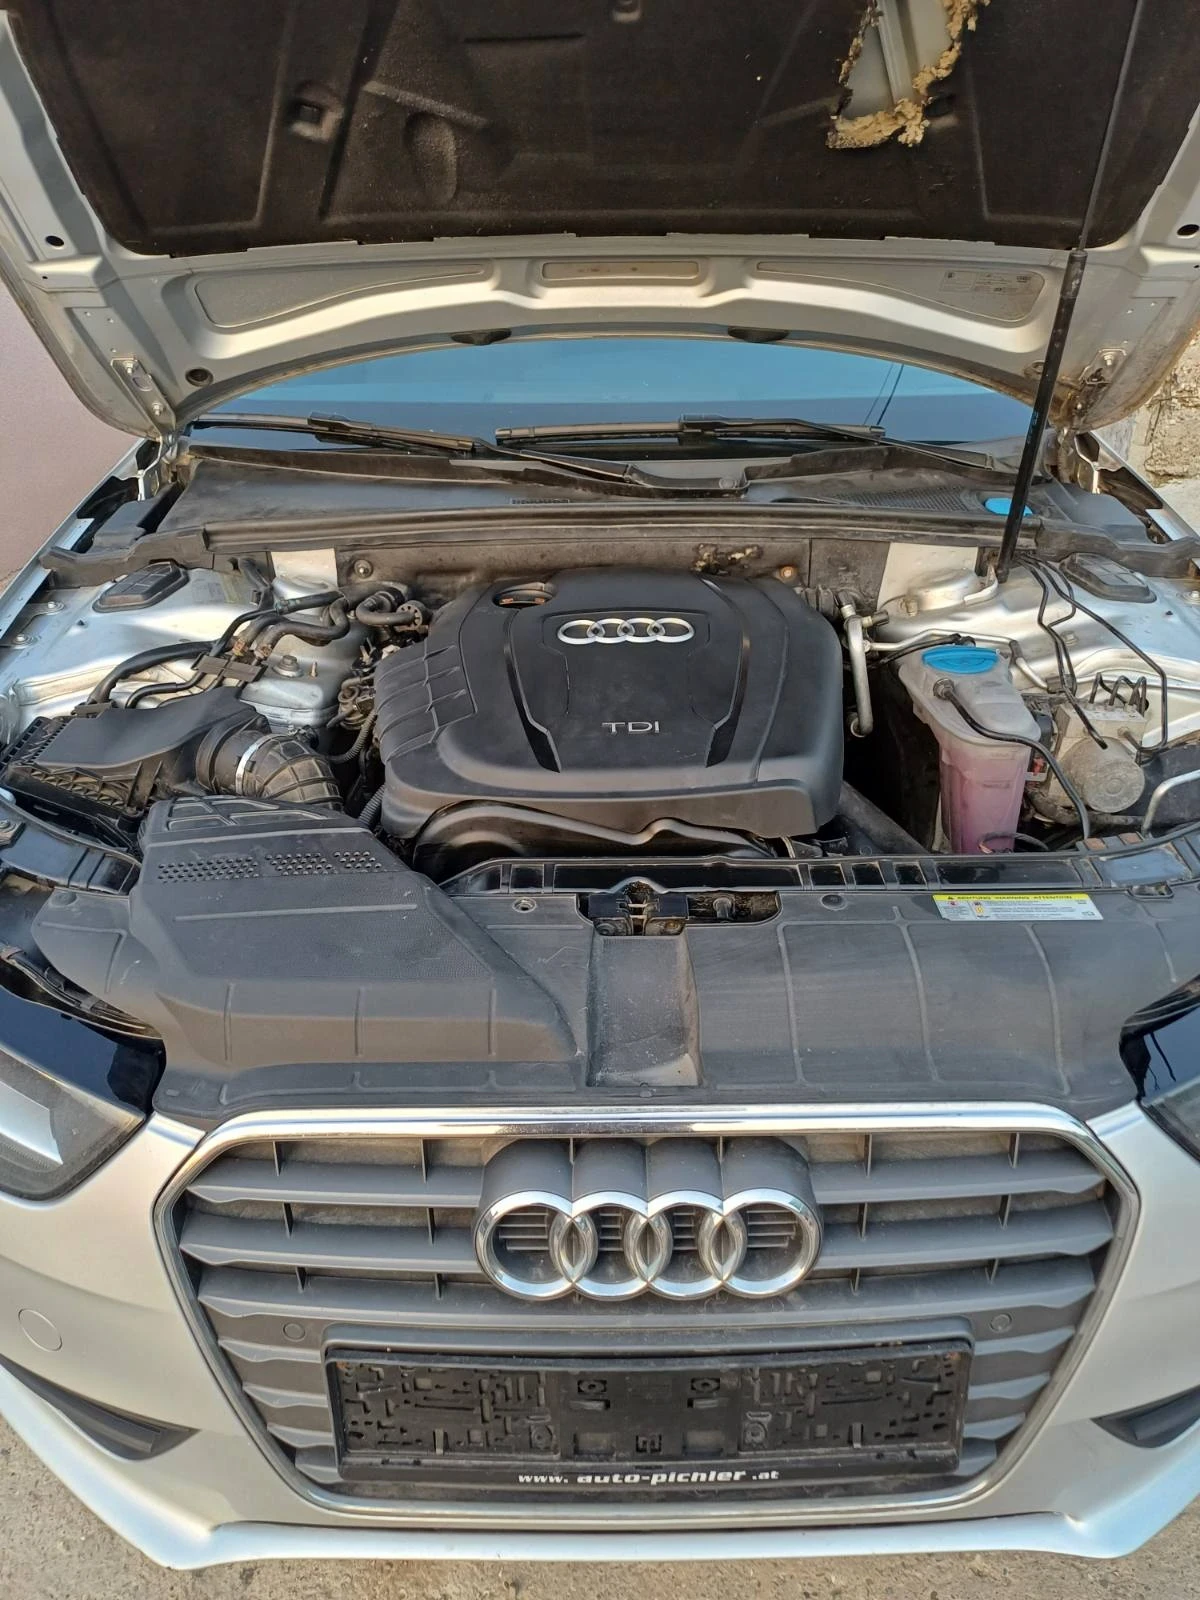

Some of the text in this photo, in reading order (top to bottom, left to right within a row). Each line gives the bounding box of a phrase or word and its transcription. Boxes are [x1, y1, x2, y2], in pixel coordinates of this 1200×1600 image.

[601, 721, 660, 734] TDI
[518, 1470, 779, 1485] www. auto-pichler .at
